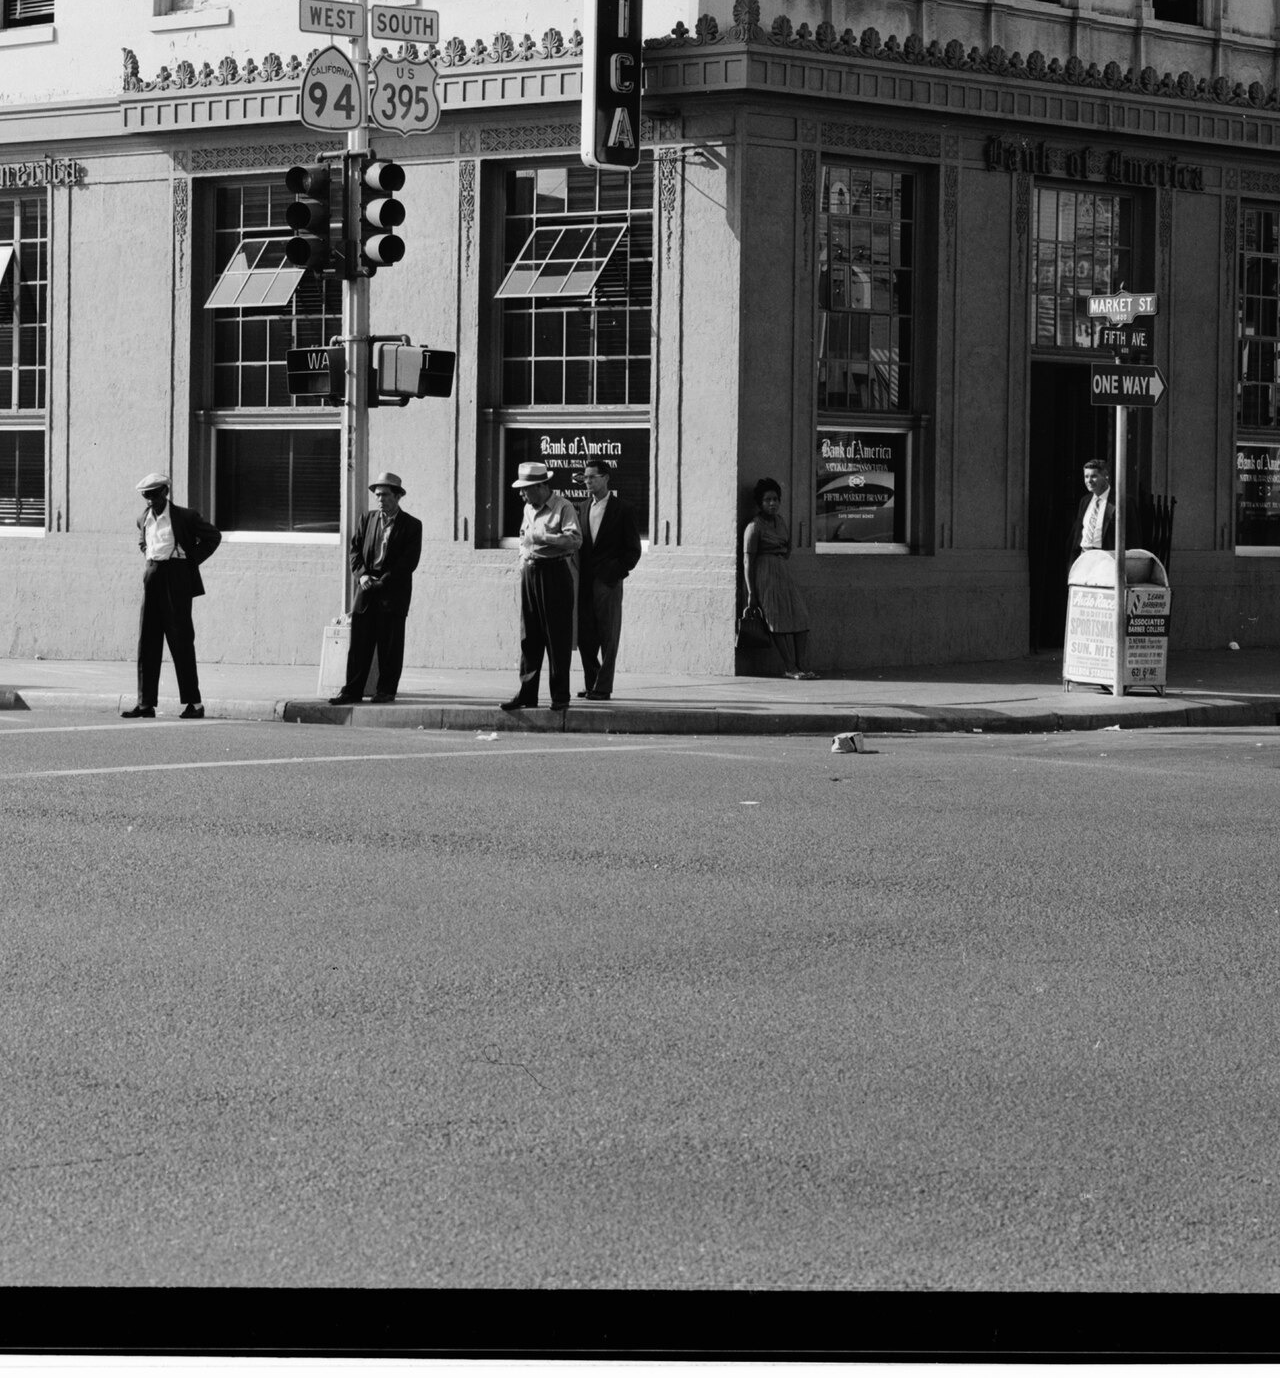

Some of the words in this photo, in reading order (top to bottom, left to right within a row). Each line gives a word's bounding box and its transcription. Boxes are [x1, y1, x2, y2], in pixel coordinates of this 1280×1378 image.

[309, 5, 356, 30] WEST
[376, 13, 434, 36] SOUTH
[310, 65, 354, 80] CALIFORNIA
[308, 81, 356, 120] 94
[381, 83, 429, 122] 395
[1089, 298, 1133, 313] MARKET
[1138, 297, 1154, 311] ST.
[1103, 330, 1126, 345] FIFTH
[1131, 331, 1148, 347] AVE.
[307, 352, 330, 370] WA
[1093, 374, 1119, 394] ONE
[1122, 375, 1148, 395] WAY
[540, 435, 567, 455] Bank
[568, 436, 580, 455] of
[578, 435, 622, 455] America
[821, 438, 845, 459] Bank
[846, 440, 857, 459] of
[855, 439, 892, 459] America
[1236, 452, 1256, 470] Bank
[1070, 617, 1114, 639] SPORTSMA
[1129, 618, 1165, 626] ASSOCIATED
[1146, 625, 1166, 633] COLLEGE
[1094, 643, 1115, 659] NITE
